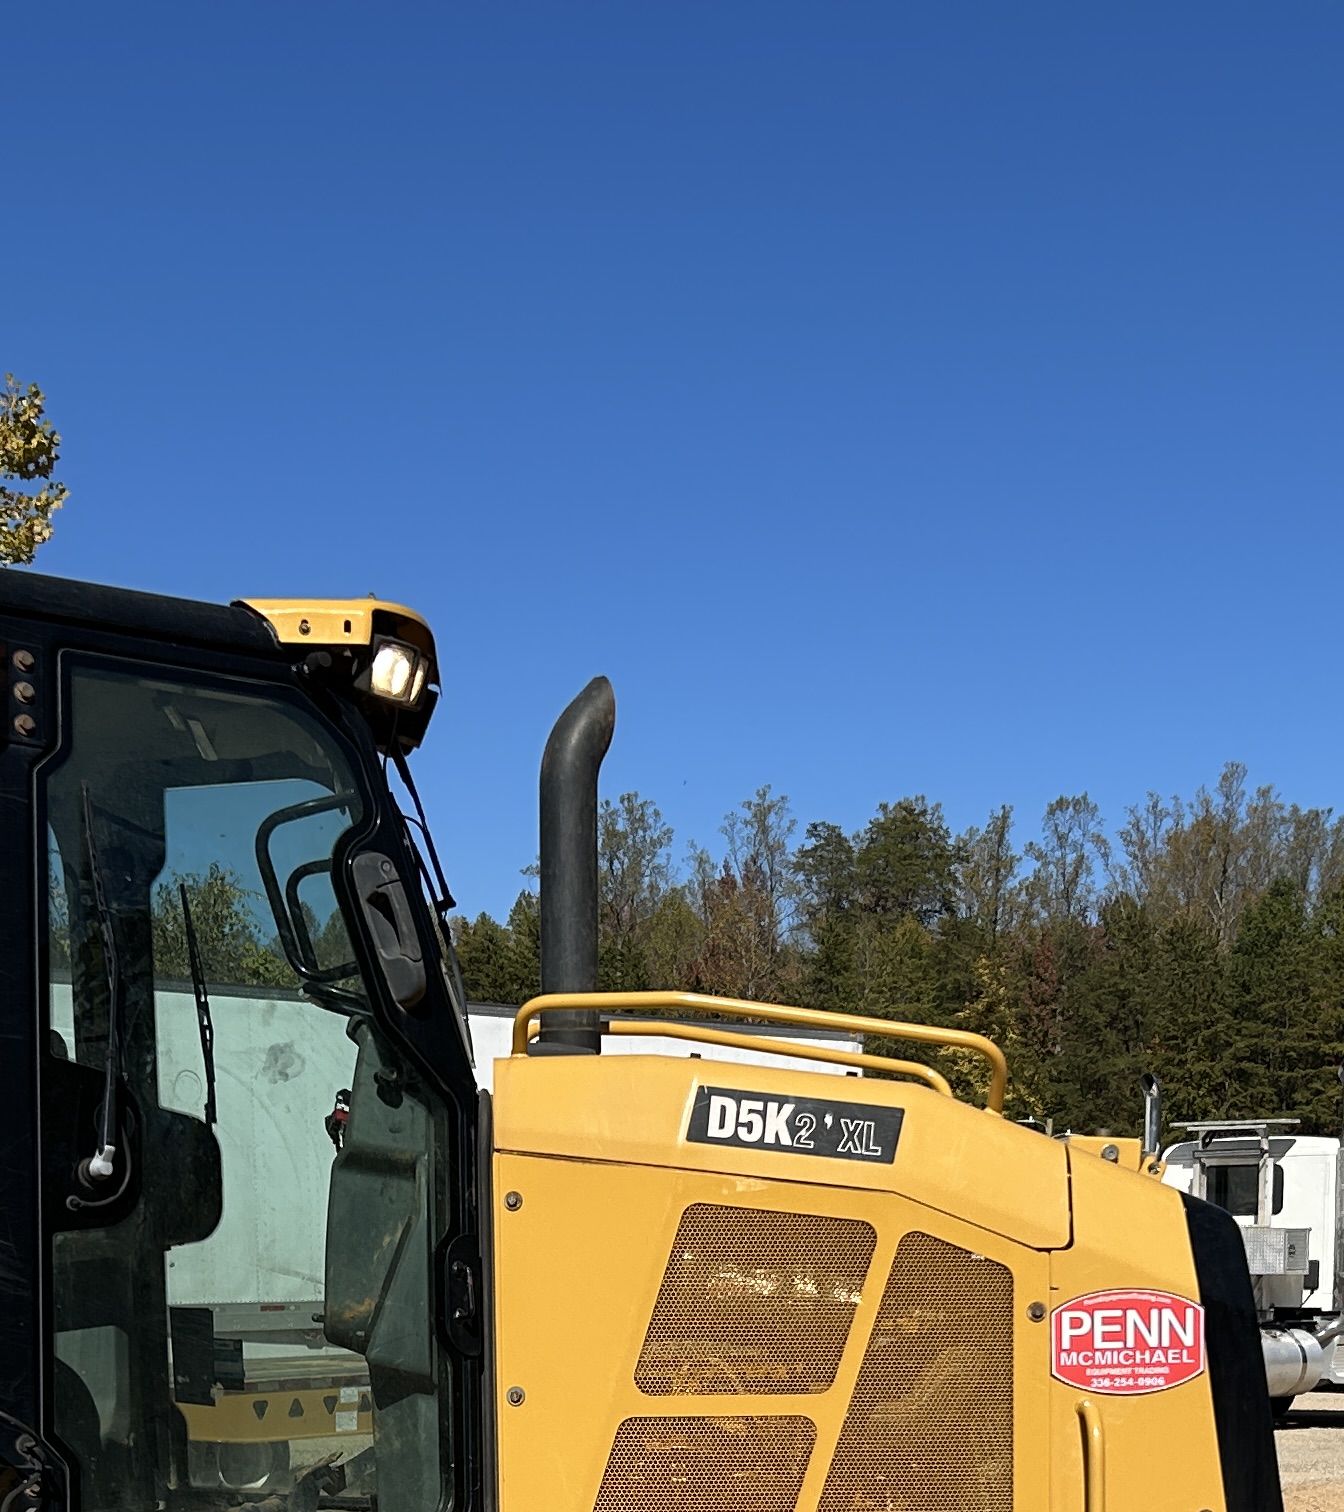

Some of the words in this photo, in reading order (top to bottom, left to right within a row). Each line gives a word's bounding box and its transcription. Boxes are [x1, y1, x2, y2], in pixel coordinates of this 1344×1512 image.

[837, 1118, 882, 1156] XL
[1061, 1308, 1194, 1350] PENN
[1060, 1349, 1195, 1366] MCMICHAEL
